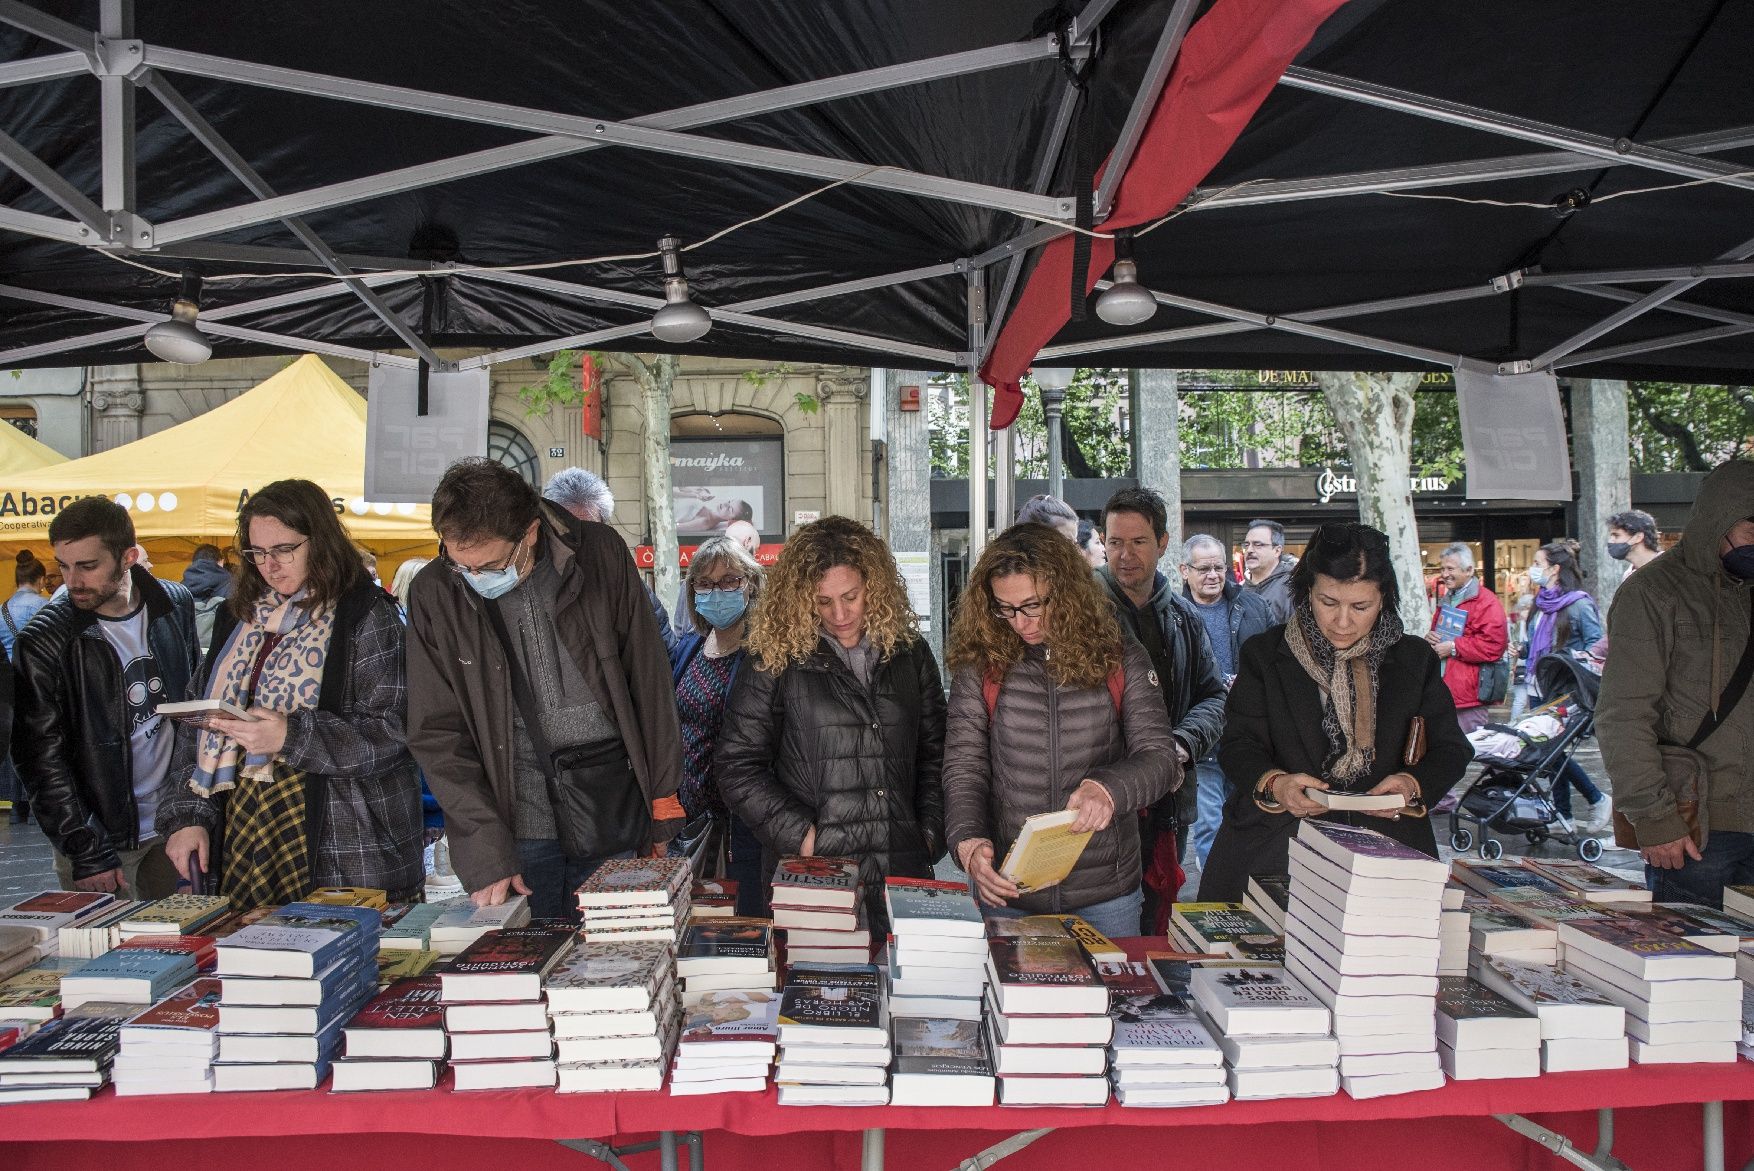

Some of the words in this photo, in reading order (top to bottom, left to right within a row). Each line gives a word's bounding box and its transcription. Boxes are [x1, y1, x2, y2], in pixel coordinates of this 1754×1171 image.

[551, 448, 564, 457] 32
[675, 453, 744, 471] mayka
[382, 1012, 424, 1020] KEN
